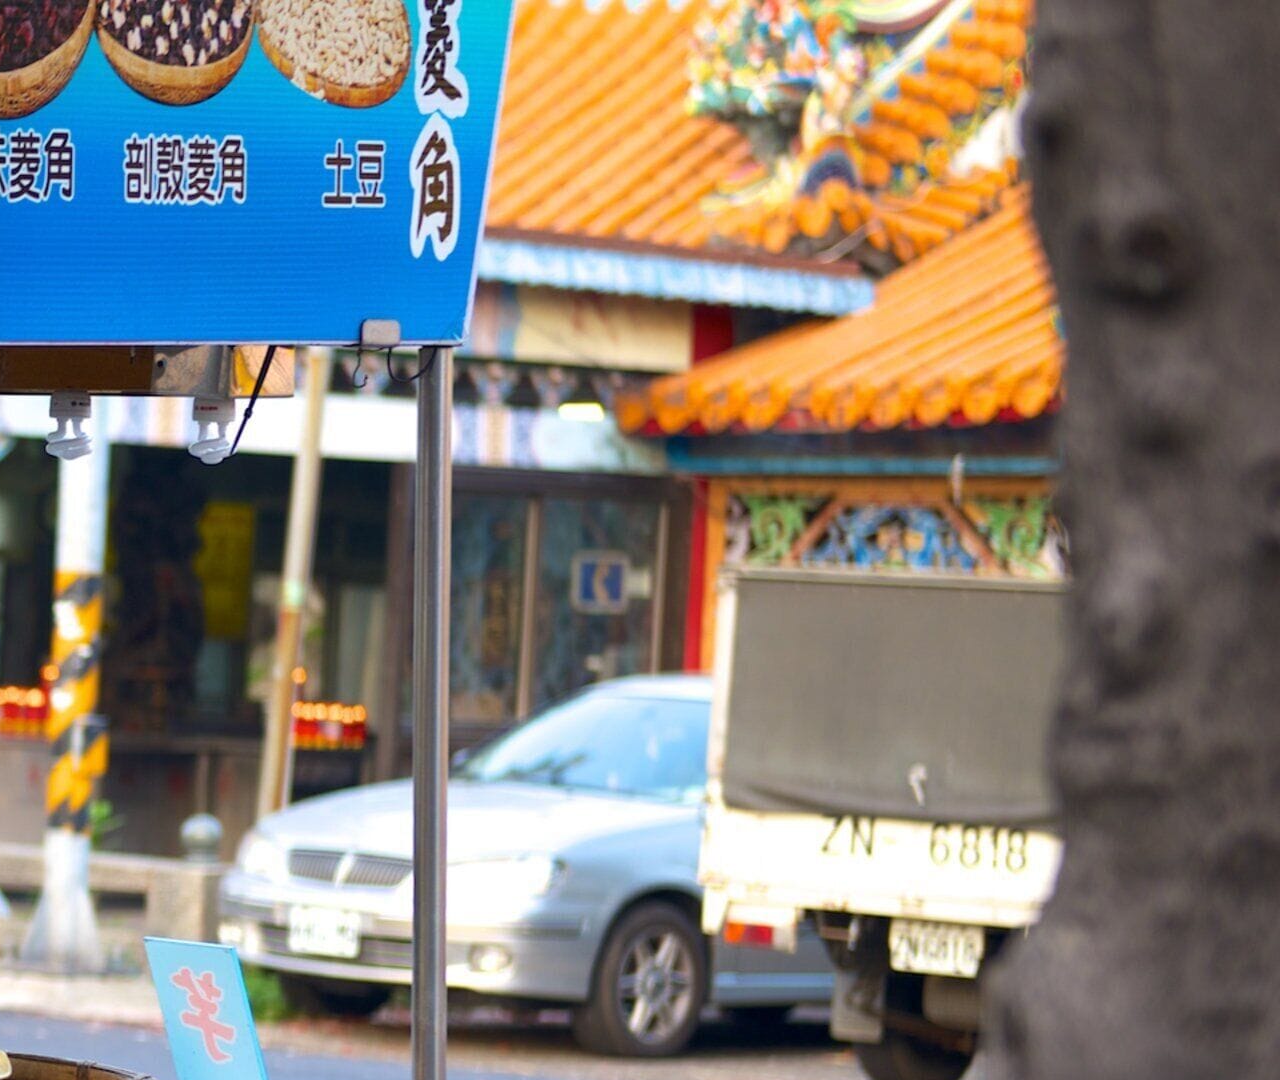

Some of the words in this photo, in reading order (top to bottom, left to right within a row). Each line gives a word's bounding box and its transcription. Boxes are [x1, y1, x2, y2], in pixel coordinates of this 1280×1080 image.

[125, 135, 246, 202] 剖殼菱角
[324, 140, 385, 205] 土豆
